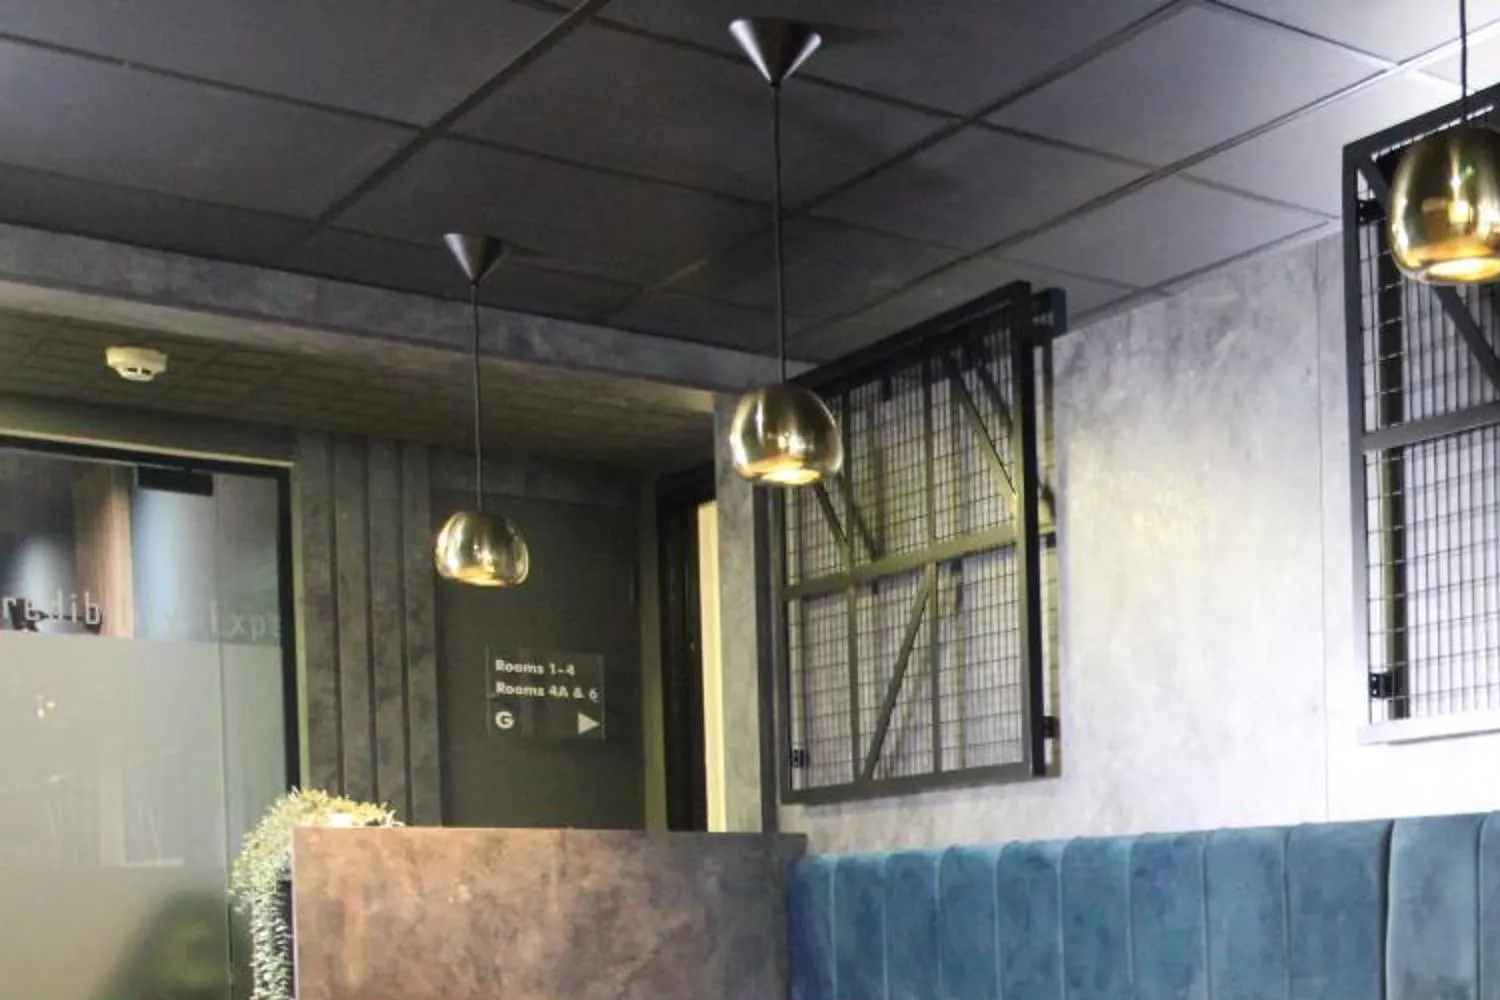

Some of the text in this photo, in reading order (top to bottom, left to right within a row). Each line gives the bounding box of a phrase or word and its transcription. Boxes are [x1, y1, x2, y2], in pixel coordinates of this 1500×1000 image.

[495, 659, 545, 675] Rooms
[495, 681, 545, 698] Rooms
[495, 710, 515, 729] G
